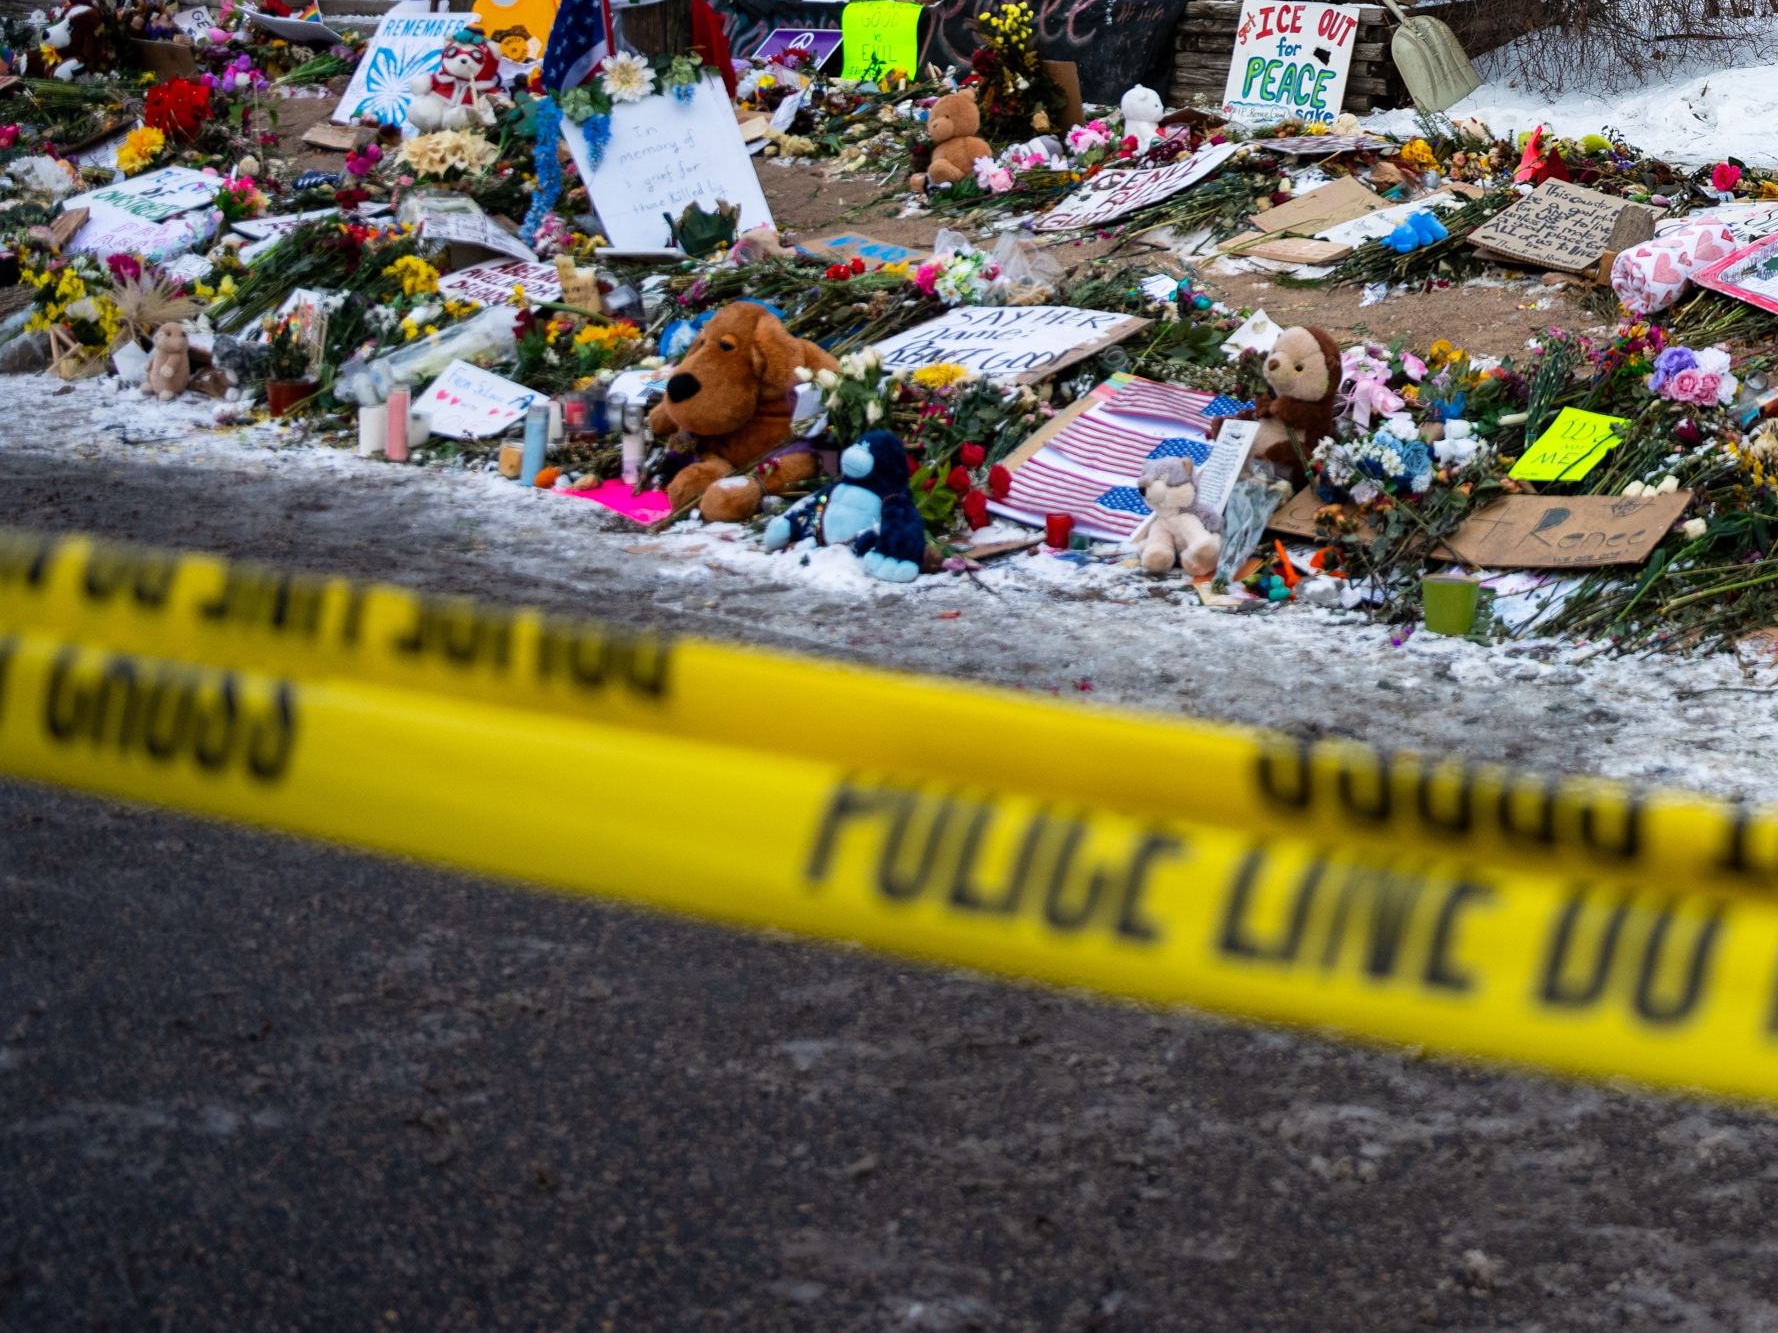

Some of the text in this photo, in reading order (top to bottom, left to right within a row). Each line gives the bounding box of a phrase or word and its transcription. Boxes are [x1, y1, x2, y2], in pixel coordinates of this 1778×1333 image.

[861, 11, 900, 28] GOOD
[1238, 12, 1256, 45] get
[1256, 5, 1358, 47] ICE OUT
[862, 44, 898, 62] EVIL
[1276, 36, 1302, 57] for
[1242, 56, 1337, 109] PEACE
[632, 125, 658, 139] In
[620, 129, 696, 165] memory of
[679, 160, 701, 179] for
[708, 180, 729, 199] by
[1546, 182, 1571, 200] This
[1526, 192, 1543, 204] be
[1549, 202, 1559, 210] a
[1503, 210, 1540, 226] unless
[1562, 226, 1596, 240] make
[1571, 218, 1588, 228] to
[1483, 223, 1517, 236] ALL
[1518, 233, 1539, 241] of
[1536, 238, 1553, 246] us
[1544, 231, 1582, 244] place
[955, 308, 1117, 330] SAY HER
[1530, 452, 1580, 465] ME
[1515, 507, 1648, 550] Renee
[800, 776, 1192, 946] POLICE
[1214, 847, 1497, 996] LINE
[1534, 893, 1730, 1029] DO
